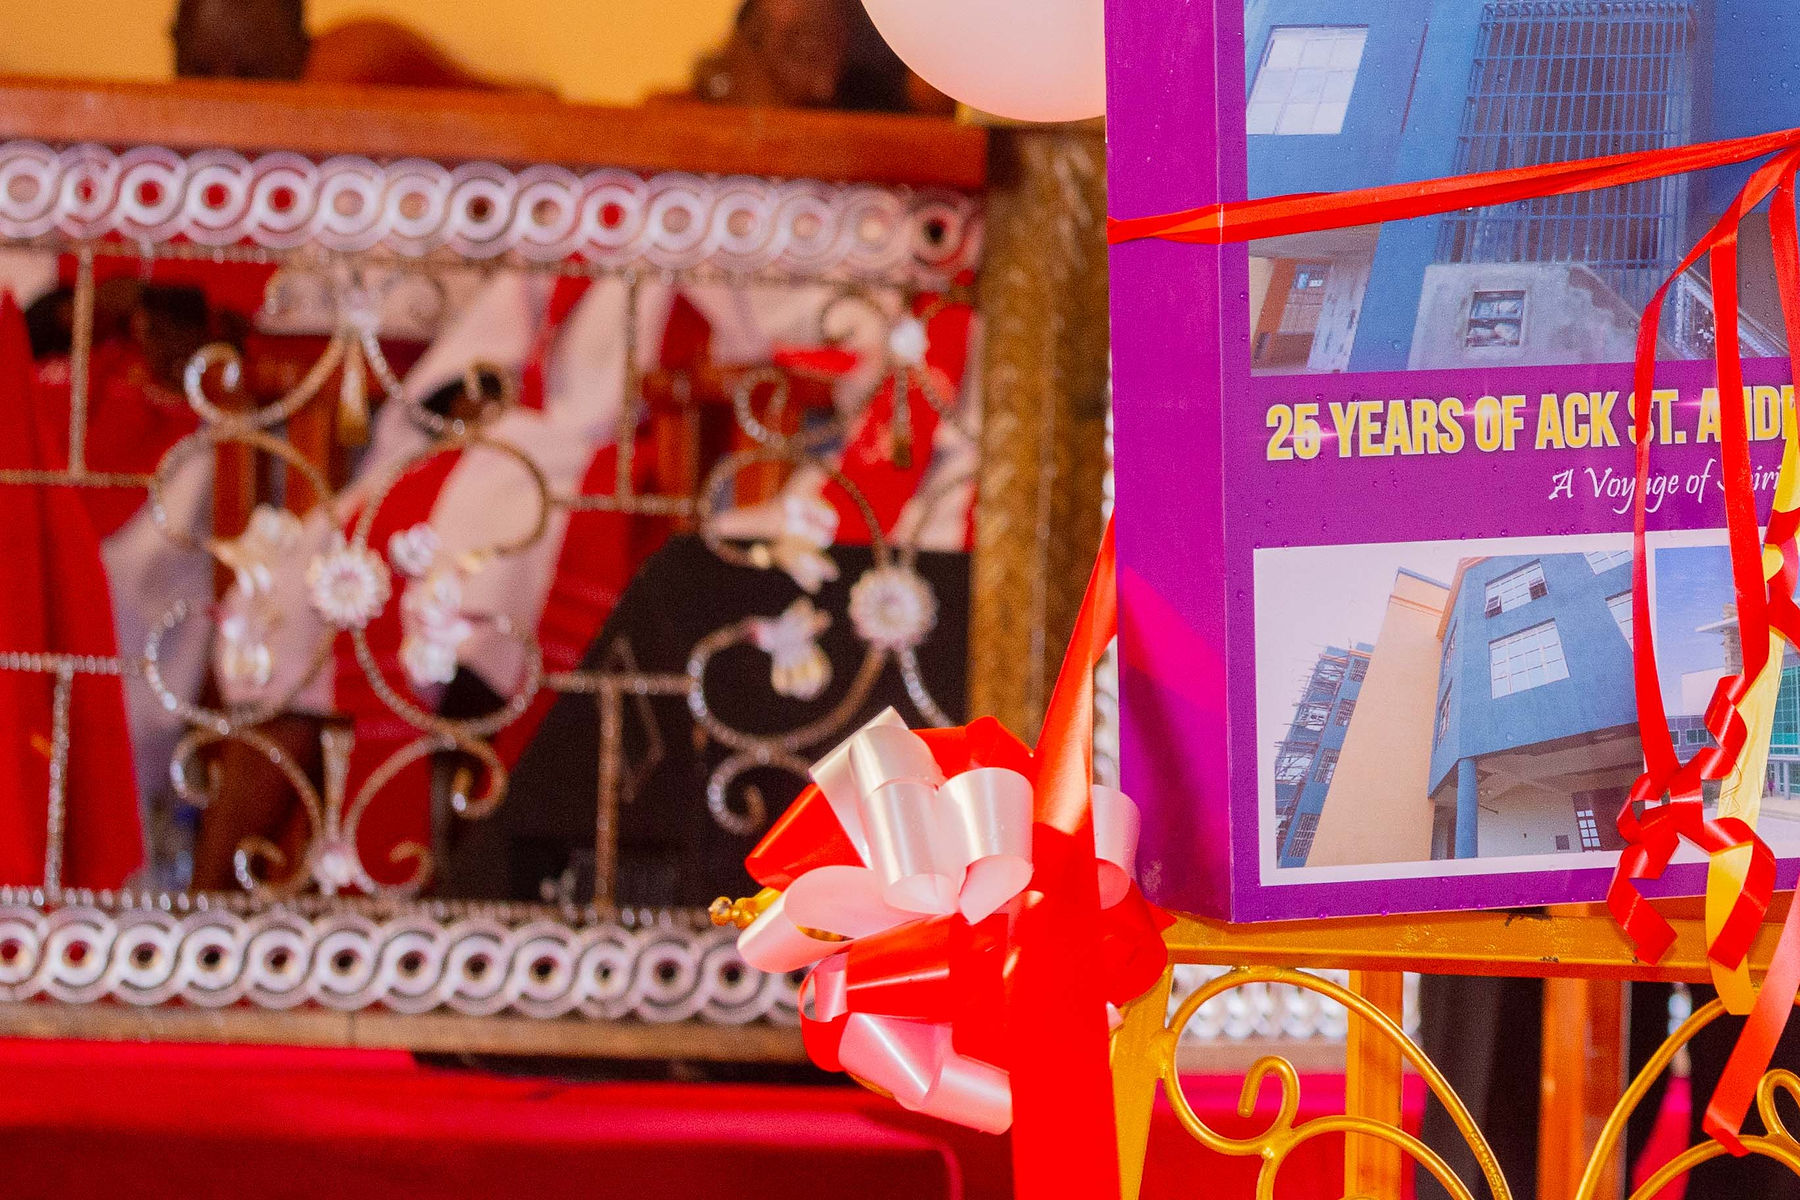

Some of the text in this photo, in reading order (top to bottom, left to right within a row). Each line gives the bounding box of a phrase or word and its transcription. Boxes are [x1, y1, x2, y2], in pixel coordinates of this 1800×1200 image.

[1266, 402, 1321, 461] 25
[1328, 397, 1465, 458] YEARS
[1474, 394, 1526, 453] OF
[1535, 391, 1621, 450] ACK
[1548, 468, 1574, 500] A
[1686, 458, 1716, 504] of
